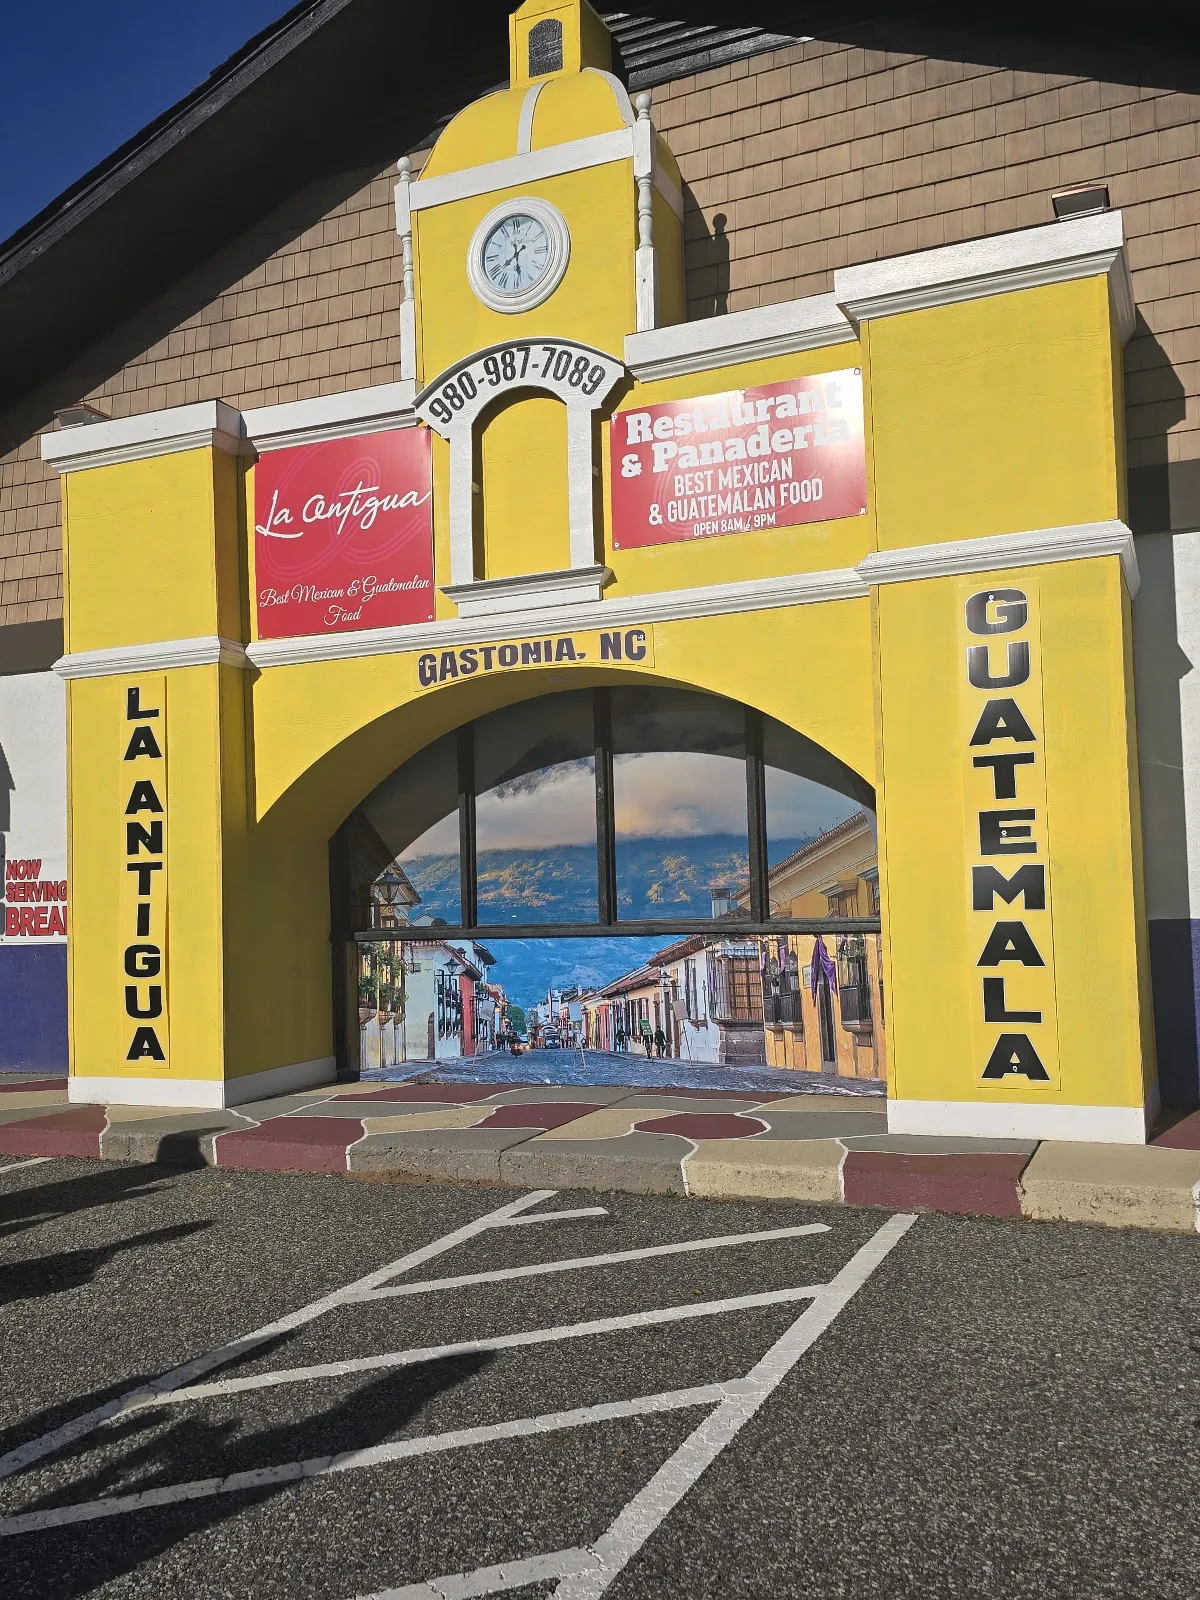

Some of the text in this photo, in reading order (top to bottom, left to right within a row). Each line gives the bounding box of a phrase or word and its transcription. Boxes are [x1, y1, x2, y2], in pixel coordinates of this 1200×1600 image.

[428, 346, 606, 424] 980-987-7089
[625, 382, 842, 445] Restaurant
[621, 453, 642, 478] &
[674, 456, 793, 497] BEST MEXICAN
[255, 480, 431, 539] La Antigua
[648, 477, 824, 526] & GUATEMALAN FOOD
[693, 520, 719, 536] OPEN
[721, 517, 743, 532] 8AM
[754, 512, 776, 528] 9PM
[259, 574, 431, 607] Best Mexican & Guatemalan
[323, 605, 363, 626] Food
[418, 629, 646, 687] GASTONIA, NC
[964, 587, 1051, 1081] GUATEMALA
[6, 859, 42, 880] NOW
[123, 686, 166, 1062] LA ANTIGUA
[5, 880, 67, 902] SERVING
[5, 906, 67, 936] BREA
